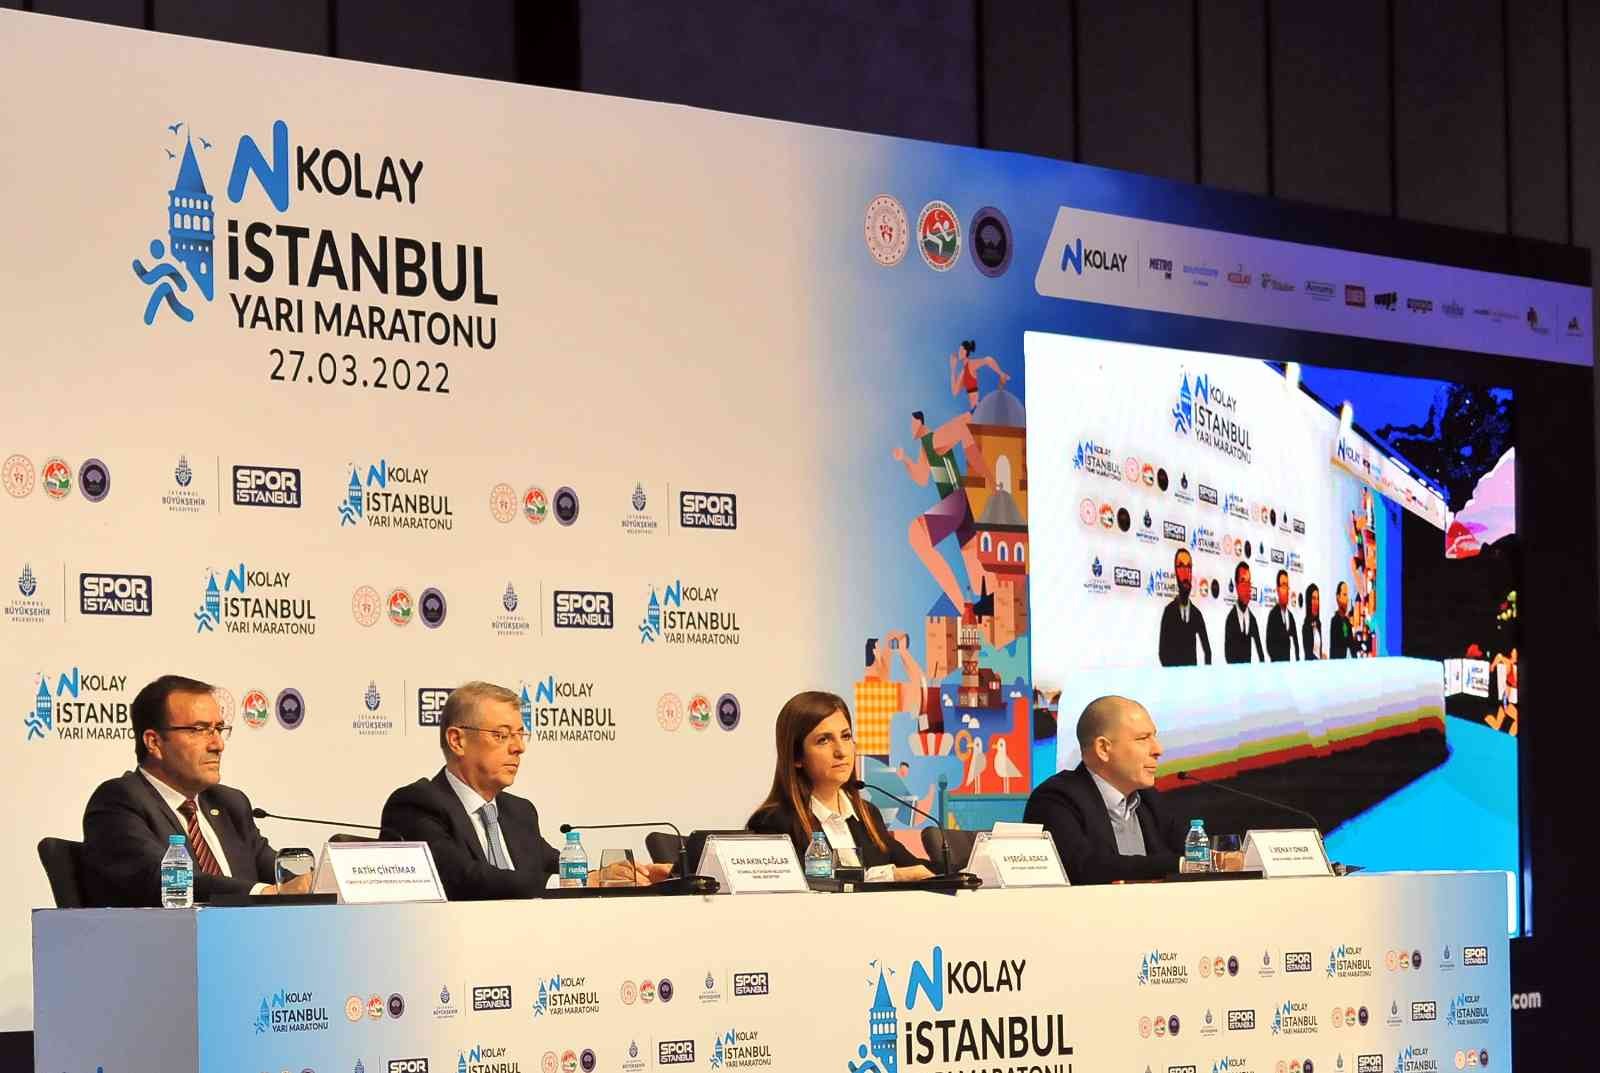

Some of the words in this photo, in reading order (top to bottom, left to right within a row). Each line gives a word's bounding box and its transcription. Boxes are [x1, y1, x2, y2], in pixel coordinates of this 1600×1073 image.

[297, 145, 424, 204] KOLAY
[1084, 248, 1127, 272] KOLAY
[229, 292, 303, 333] YARI
[314, 301, 497, 349] MARATONU
[269, 348, 450, 393] 27.03.2022
[236, 469, 297, 491] SPOR
[388, 467, 428, 484] KOLAY
[683, 495, 733, 514] SPOR
[368, 516, 390, 527] YARI
[394, 517, 452, 530] MARATONU
[248, 571, 290, 588] KOLAY
[84, 577, 147, 598] SPOR
[682, 587, 718, 601] KOLAY
[557, 594, 610, 612] SPOR
[225, 621, 249, 632] YARI
[253, 622, 315, 634] MARATONU
[665, 633, 684, 644] YARI
[687, 634, 739, 644] MARATONU
[81, 675, 127, 690] KOLAY
[556, 683, 593, 697] KOLAY
[57, 728, 83, 739] YARI
[87, 728, 135, 740] MARATO
[536, 730, 557, 741] YARI
[560, 730, 615, 741] MARATONU
[736, 975, 766, 986] SPOR
[948, 959, 1026, 994] KOLAY
[286, 992, 312, 1003] KOLAY
[475, 988, 509, 1000] SPOR
[482, 1048, 506, 1057] KOLAY
[660, 1043, 693, 1054] SPOR
[390, 1061, 426, 1073] SPOR
